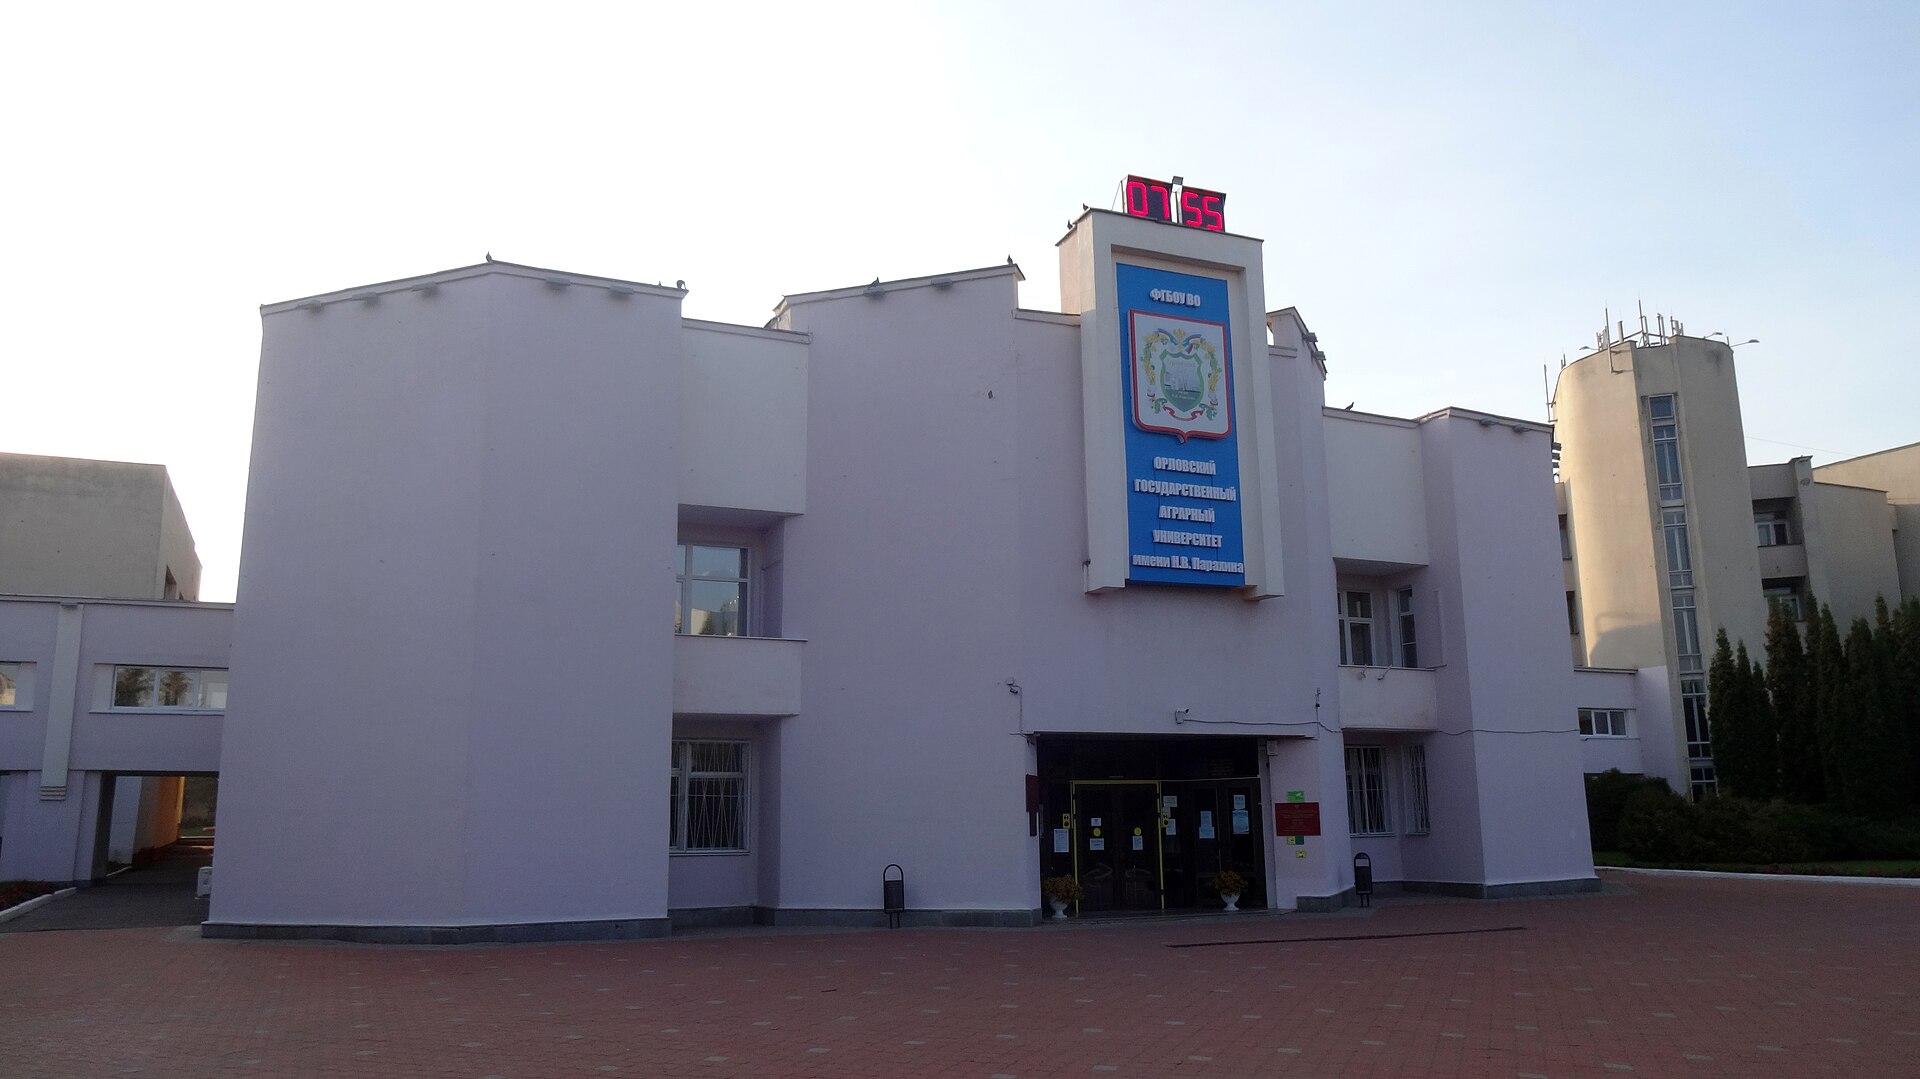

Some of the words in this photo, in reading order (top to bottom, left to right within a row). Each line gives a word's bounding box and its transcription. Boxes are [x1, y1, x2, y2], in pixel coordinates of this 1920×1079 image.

[1127, 181, 1170, 219] 07
[1181, 192, 1223, 231] 55
[1150, 288, 1186, 304] ФГБОУ
[1186, 291, 1201, 306] ВО
[1153, 456, 1216, 475] ОРЛОВСКИЙ
[1134, 479, 1236, 500] ГОСУДАРСТВЕННЫЙ
[1158, 506, 1215, 522] АГРАРНЫЙ
[1152, 529, 1222, 547] УНИВЕРСИТЕТ
[1132, 554, 1170, 568] имени
[1192, 557, 1244, 573] Парахина
